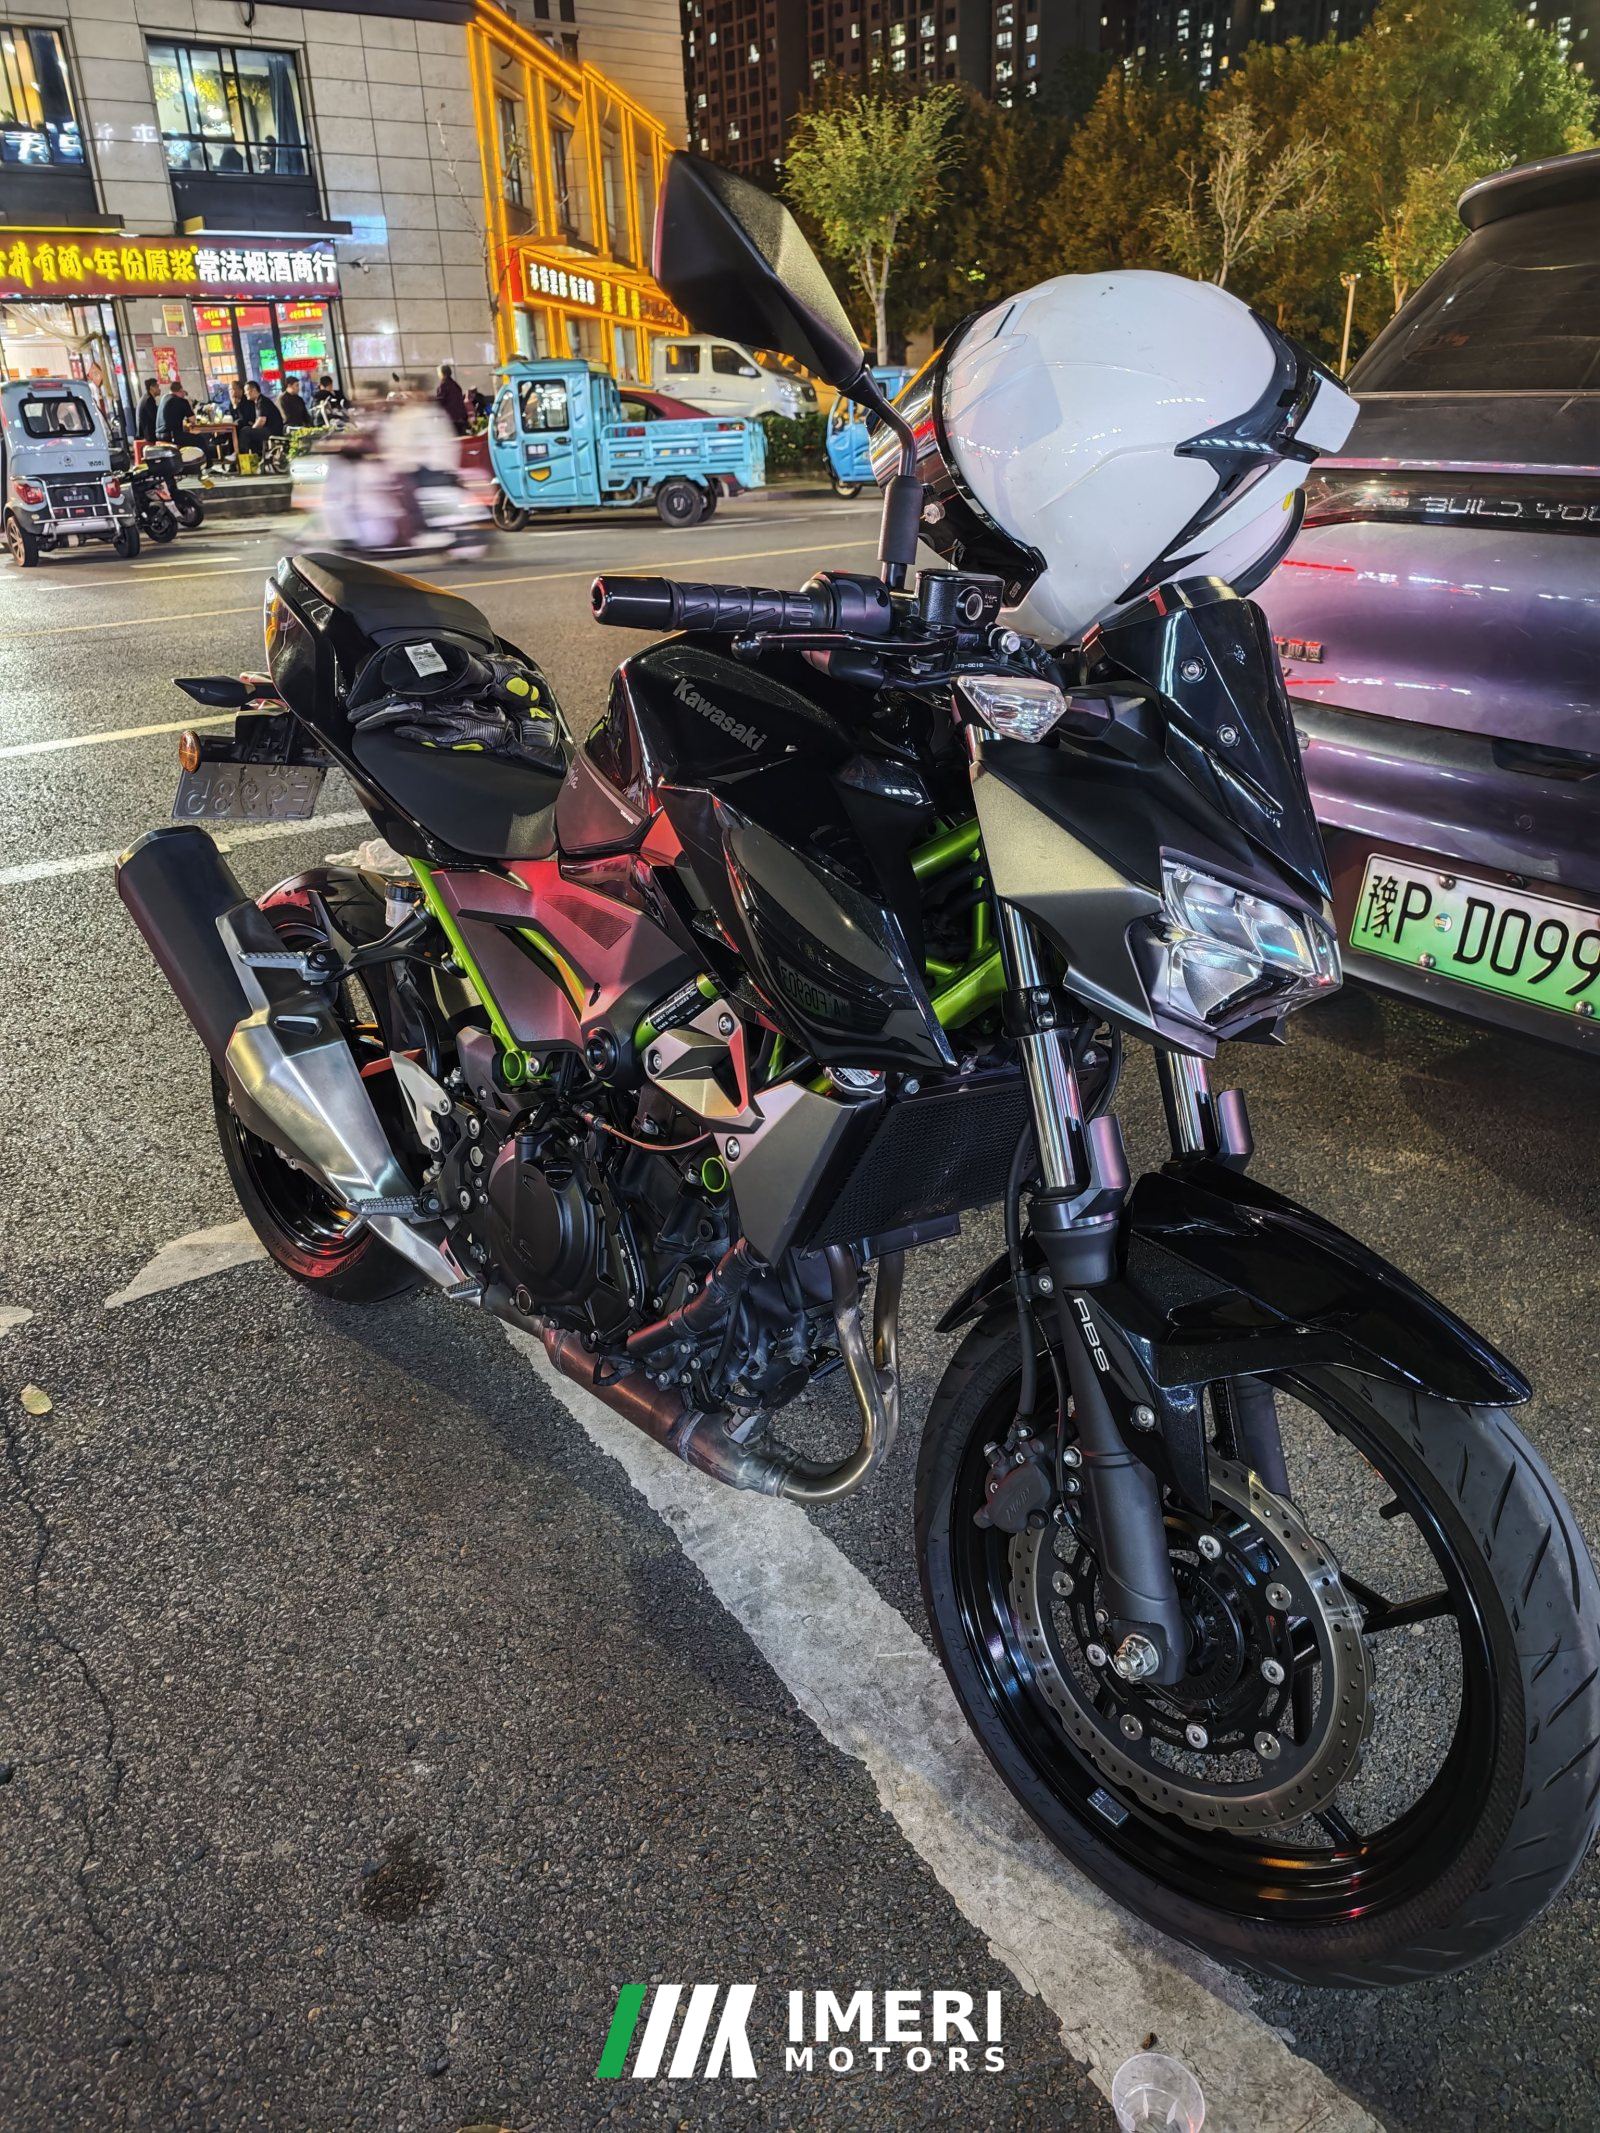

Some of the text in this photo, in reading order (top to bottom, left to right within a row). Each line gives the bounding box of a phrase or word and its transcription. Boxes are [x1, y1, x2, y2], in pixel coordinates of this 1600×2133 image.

[194, 249, 337, 283] 常法烟酒商行
[1419, 496, 1523, 518] BUILD
[673, 678, 768, 752] Kawasaki
[1453, 896, 1600, 996] D099
[1073, 1297, 1109, 1372] ABS
